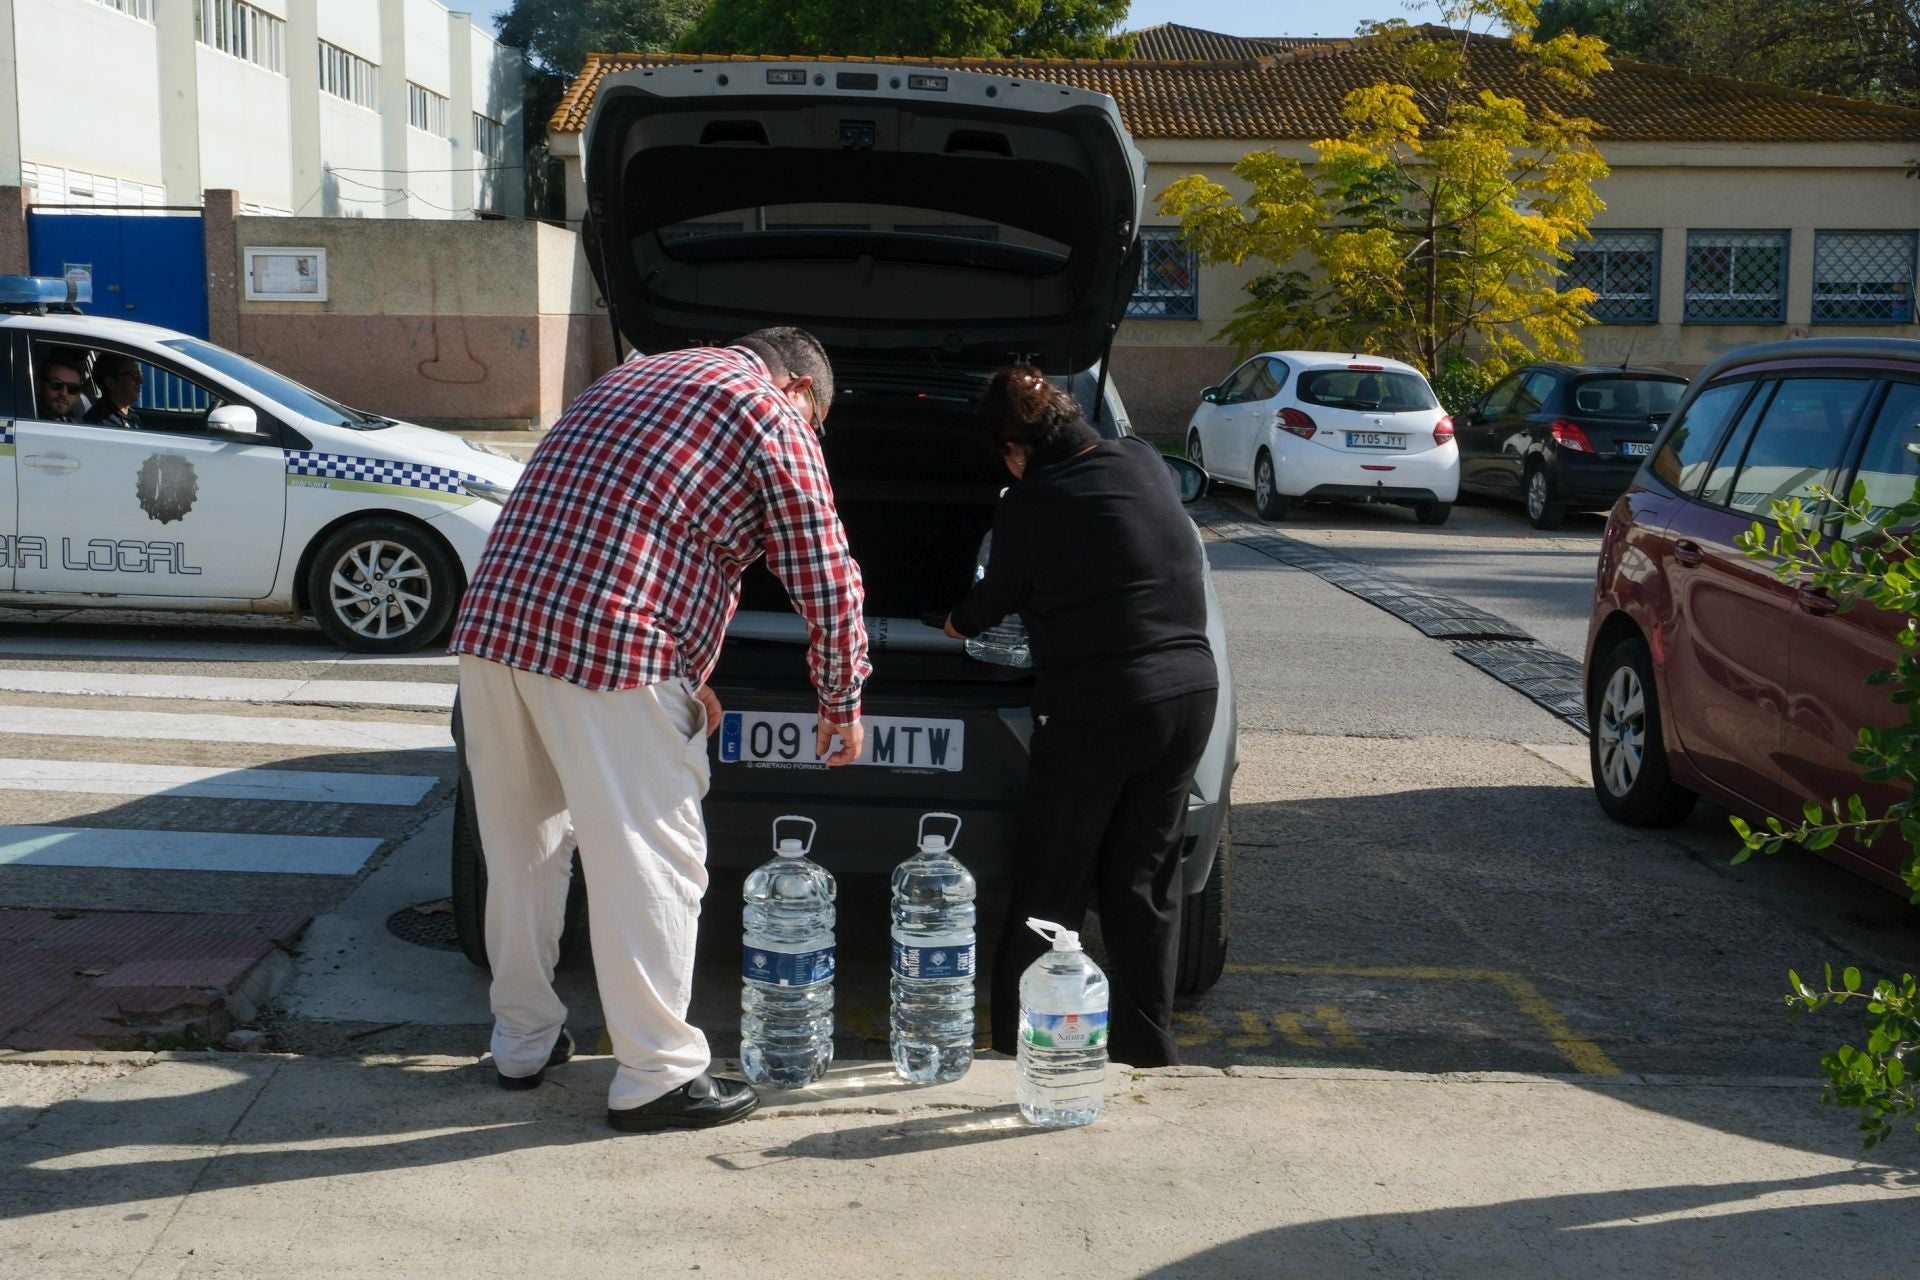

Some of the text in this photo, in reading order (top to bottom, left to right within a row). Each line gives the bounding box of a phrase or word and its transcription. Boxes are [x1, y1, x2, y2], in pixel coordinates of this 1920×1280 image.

[1353, 434, 1403, 446] 7105 JYY
[0, 535, 203, 576] IA LOCAL
[728, 742, 736, 753] E
[872, 726, 951, 766] MTW
[908, 949, 920, 978] NATURA
[957, 952, 969, 971] FONT
